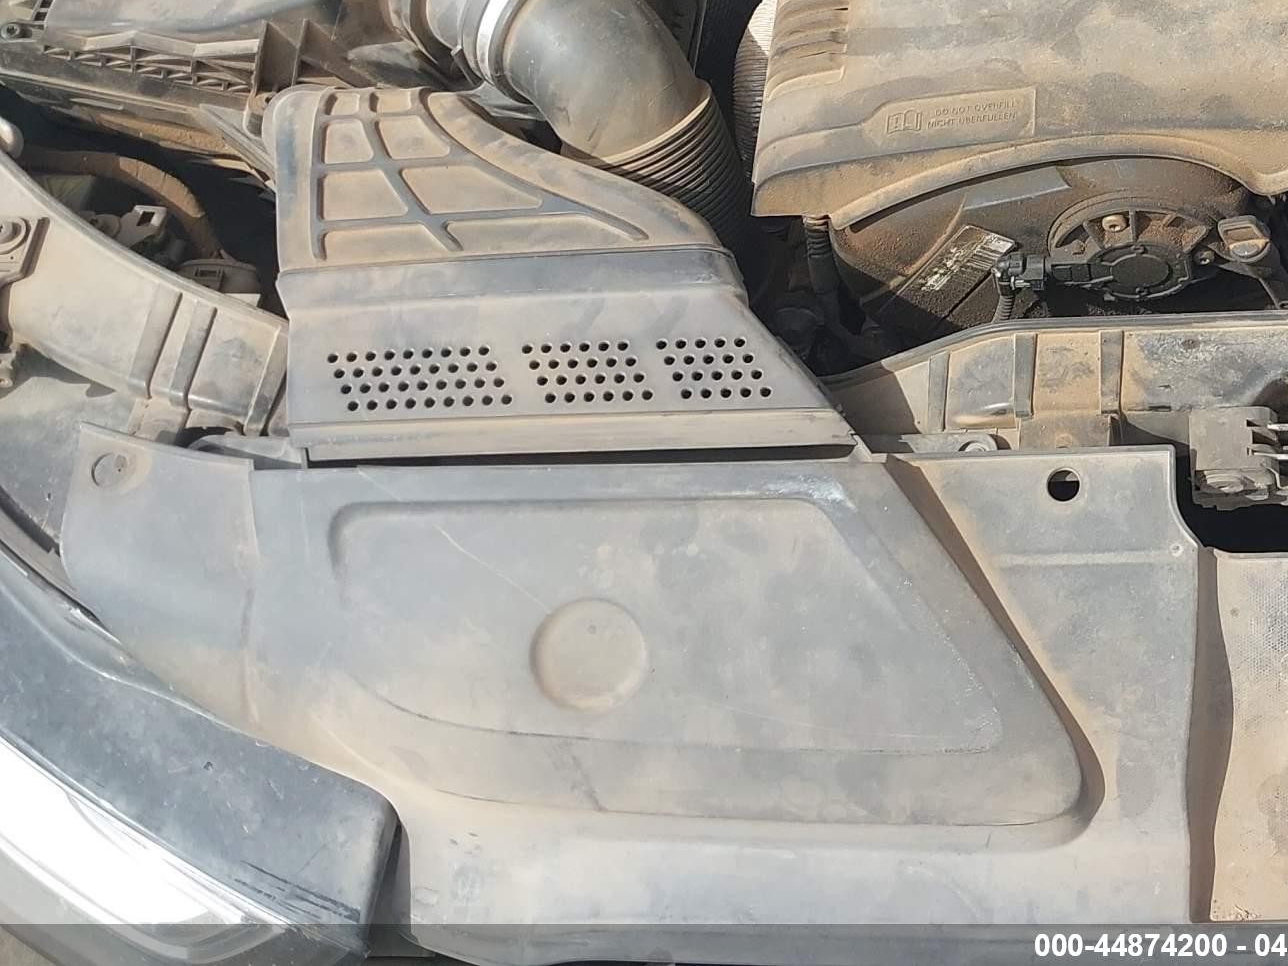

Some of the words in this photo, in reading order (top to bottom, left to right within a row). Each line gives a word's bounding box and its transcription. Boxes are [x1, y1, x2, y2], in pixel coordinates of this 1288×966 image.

[935, 108, 950, 116] DO
[951, 105, 971, 115] NOT
[927, 118, 956, 129] NICHT
